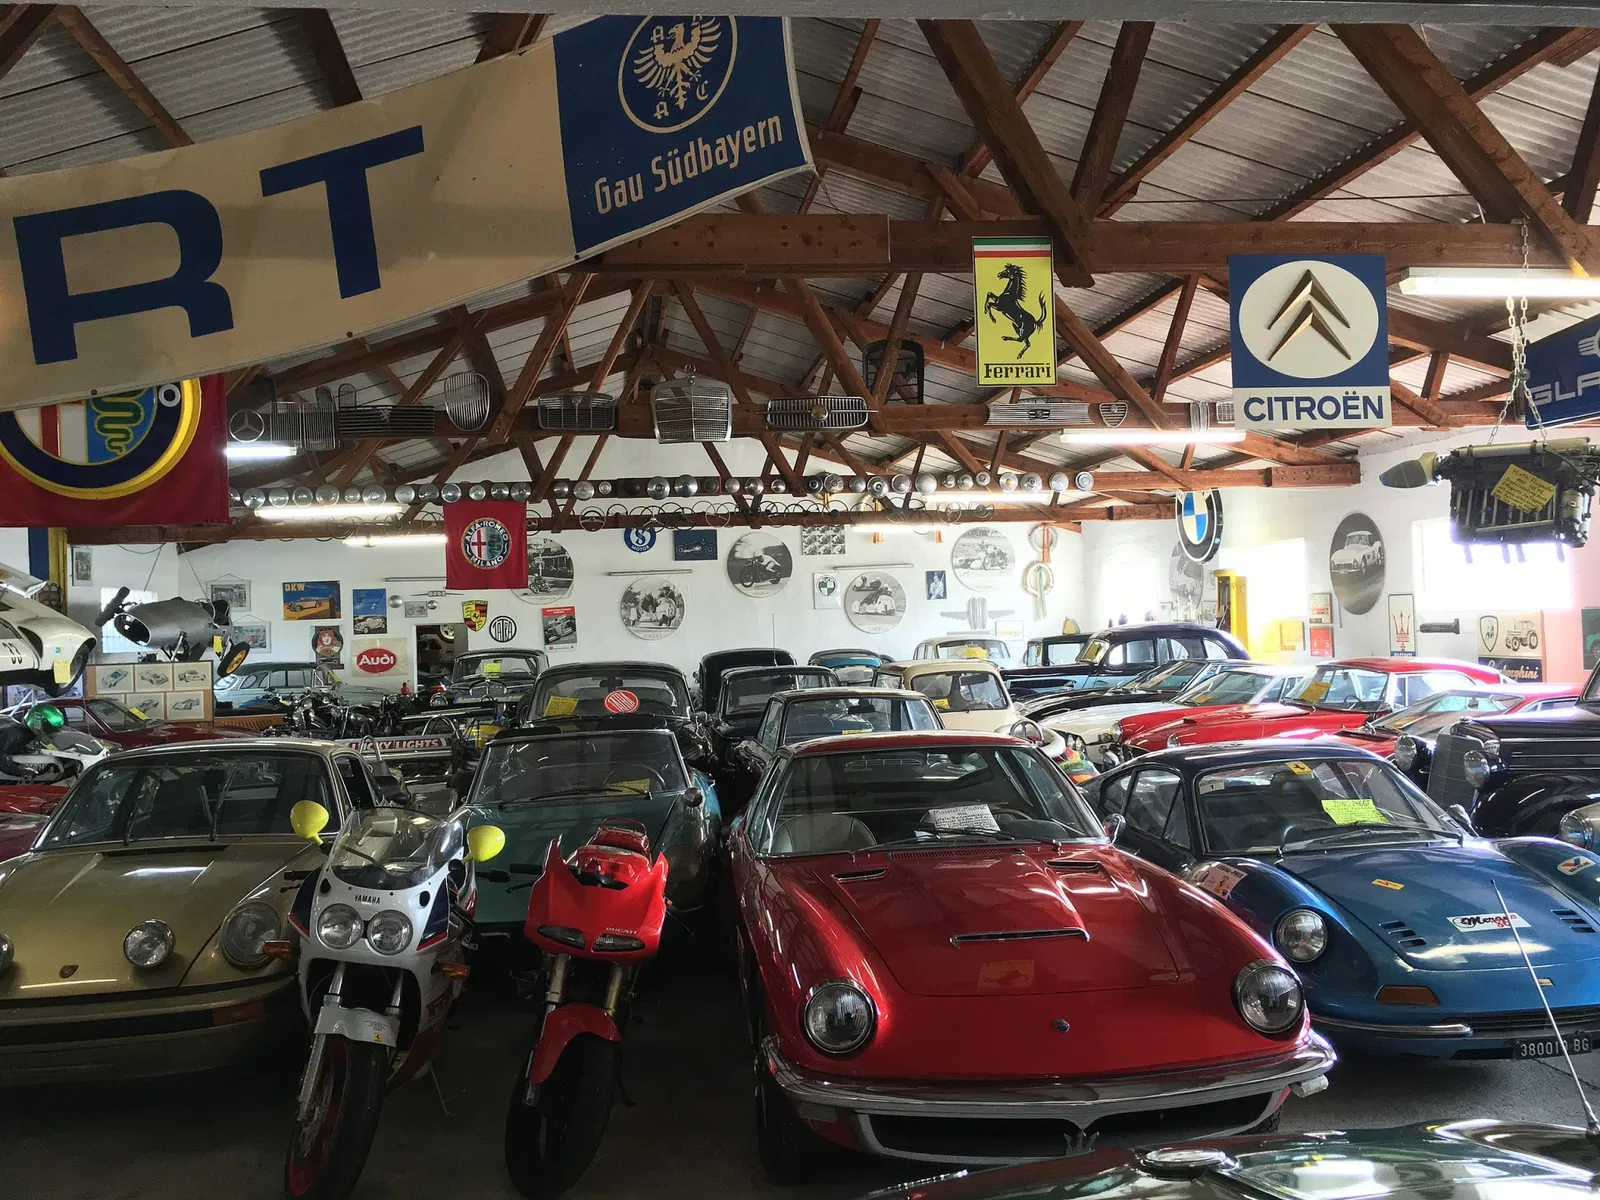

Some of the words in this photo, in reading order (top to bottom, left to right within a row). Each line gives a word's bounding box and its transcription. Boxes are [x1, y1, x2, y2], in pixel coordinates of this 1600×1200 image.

[594, 176, 644, 214] Gau
[650, 115, 783, 193] Südbayern
[13, 126, 424, 366] RT
[983, 362, 1051, 380] Ferrari
[1243, 391, 1384, 422] CITROËN
[470, 555, 504, 567] MILANO
[285, 583, 305, 592] DKW
[358, 654, 394, 666] Audi
[395, 739, 439, 750] LIGHTS
[354, 894, 381, 904] YAMAHA
[606, 927, 637, 935] DUCATI
[1573, 1038, 1589, 1052] BG
